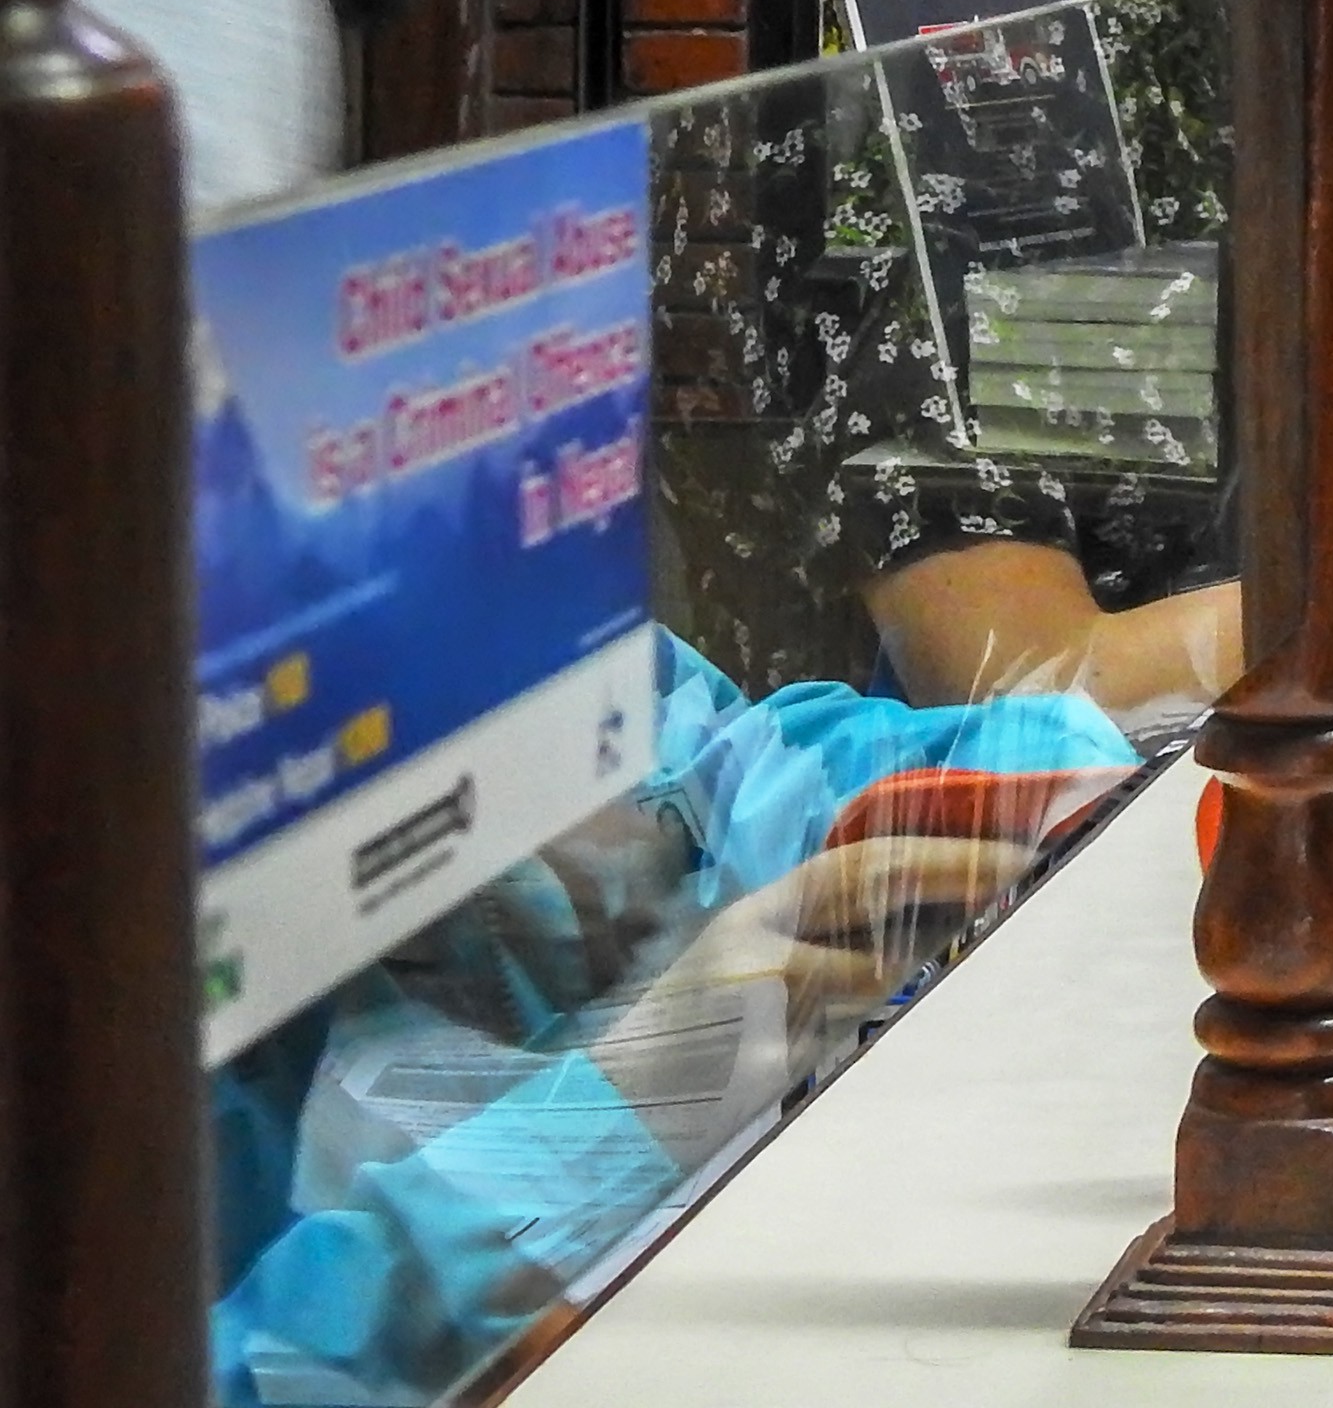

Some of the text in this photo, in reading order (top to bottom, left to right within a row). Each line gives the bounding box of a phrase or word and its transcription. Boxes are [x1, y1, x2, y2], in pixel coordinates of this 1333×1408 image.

[337, 200, 638, 360] Child Sexual Abuse
[382, 352, 518, 474] Criminal
[522, 320, 641, 420] Offence
[520, 414, 642, 548] in Nepal
